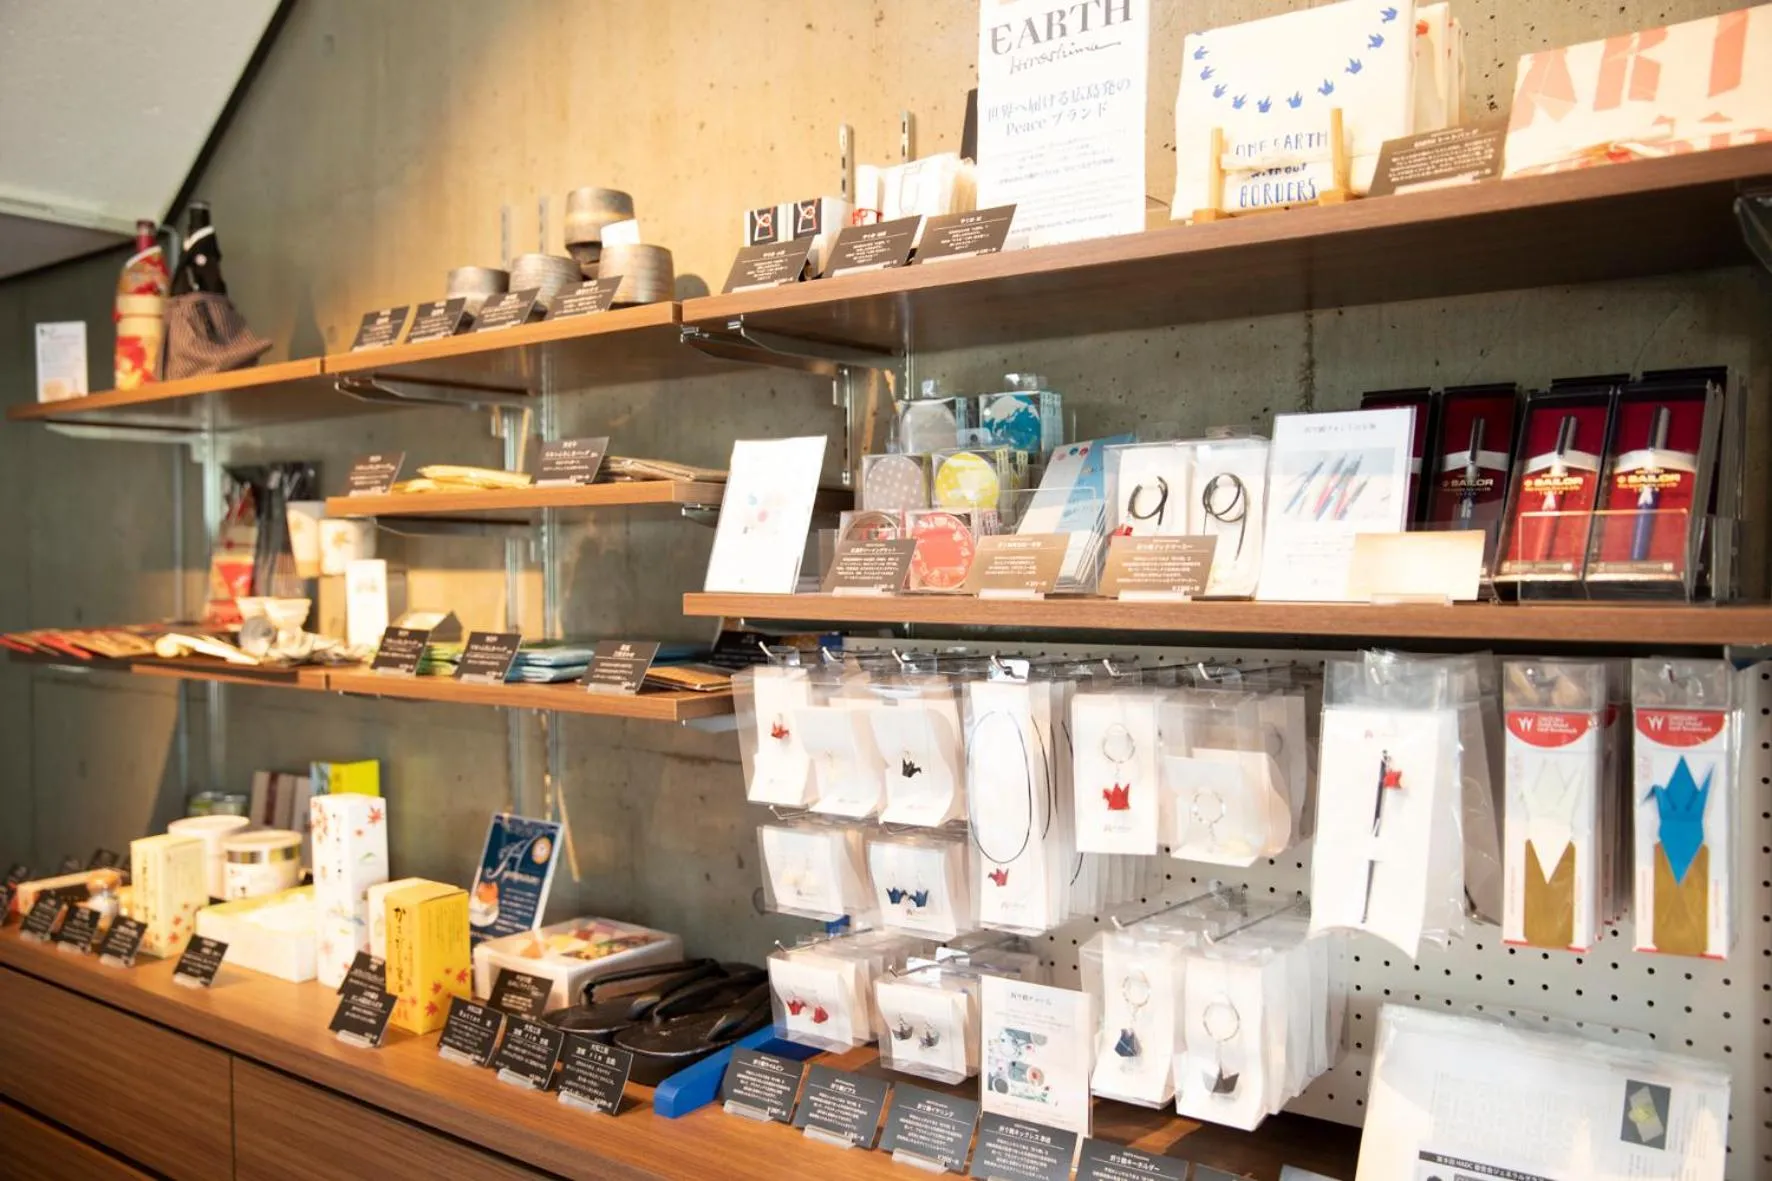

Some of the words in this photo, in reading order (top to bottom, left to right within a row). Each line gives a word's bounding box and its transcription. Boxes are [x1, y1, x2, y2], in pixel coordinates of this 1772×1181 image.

[988, 0, 1133, 56] EARTH
[1240, 177, 1317, 208] BORDERS
[1451, 478, 1494, 488] SAILOR
